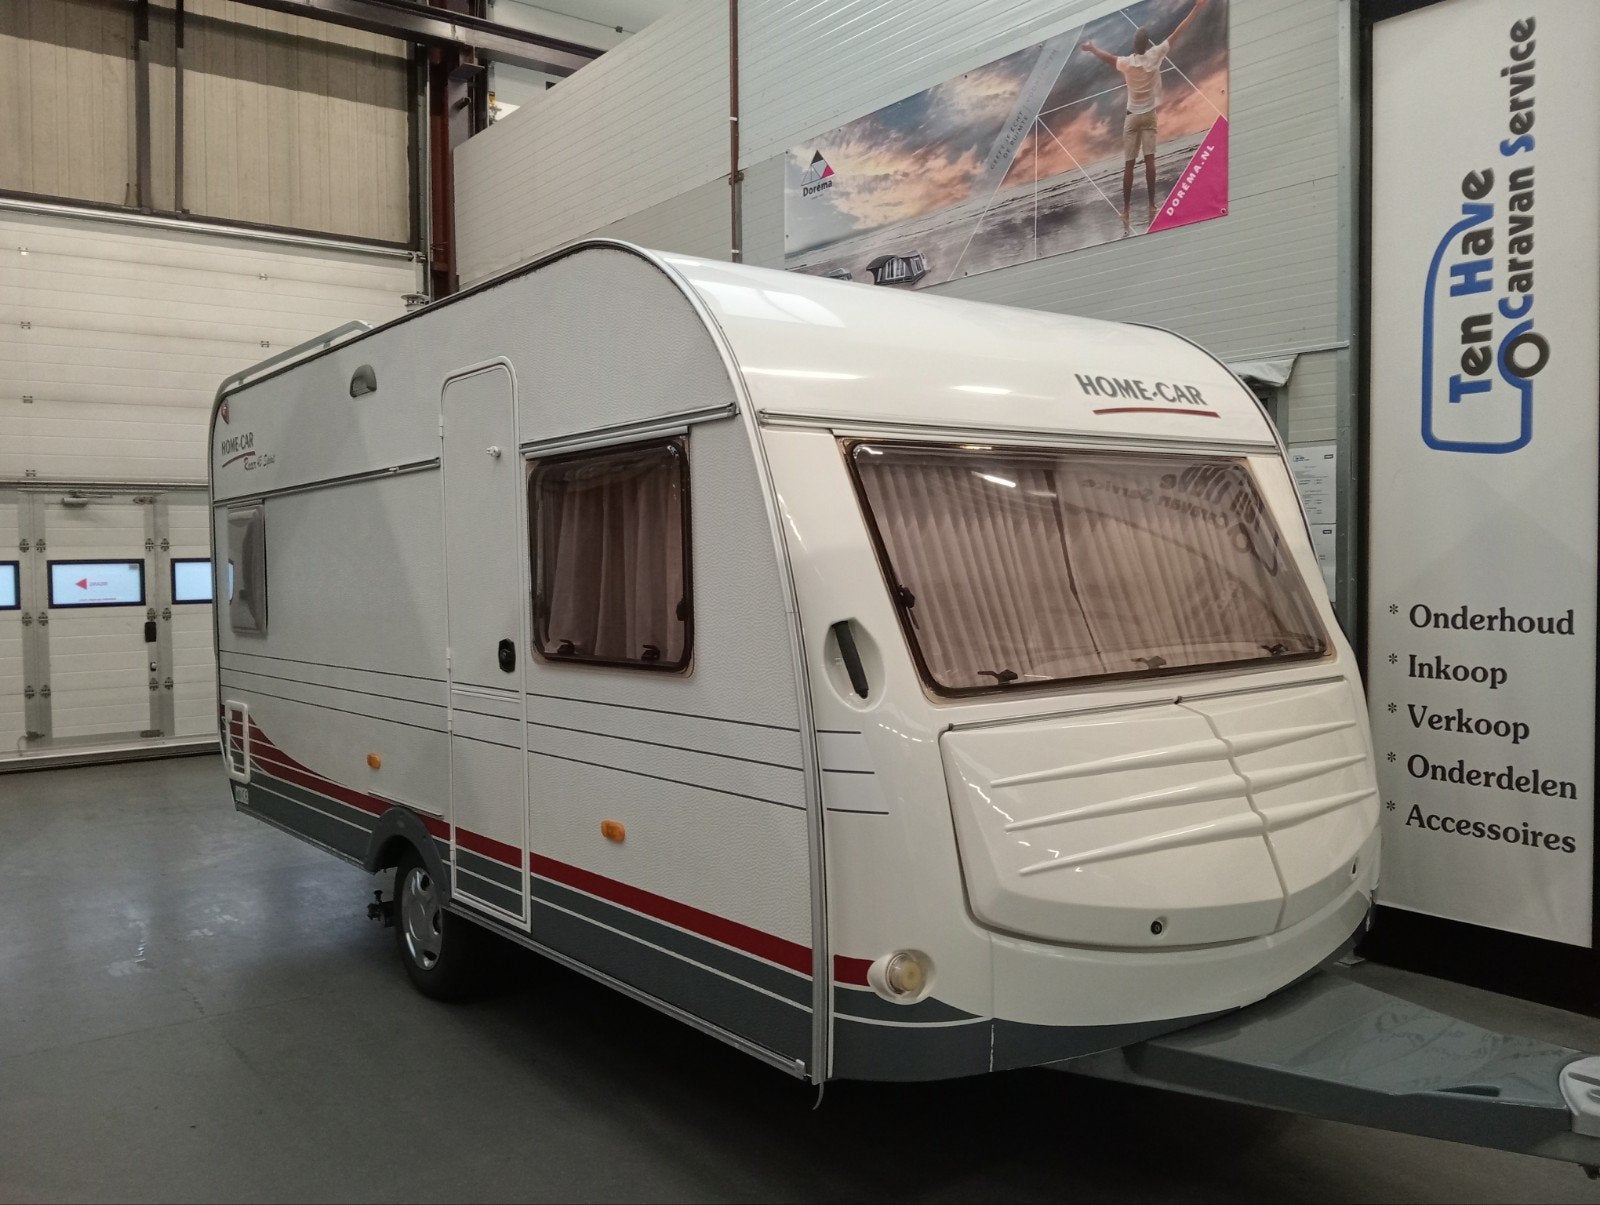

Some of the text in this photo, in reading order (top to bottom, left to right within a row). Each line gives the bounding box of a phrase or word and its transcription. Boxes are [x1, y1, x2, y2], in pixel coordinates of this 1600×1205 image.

[1166, 145, 1215, 217] DOREMA.NL
[1498, 16, 1536, 319] Caravan Service
[1448, 167, 1495, 404] Ten Have
[1409, 603, 1575, 635] Onderhoud
[1408, 654, 1508, 689] Inkoop
[1407, 703, 1530, 744] Verkoop
[1407, 753, 1577, 800] Onderdelen
[1405, 803, 1576, 853] Accessoires
